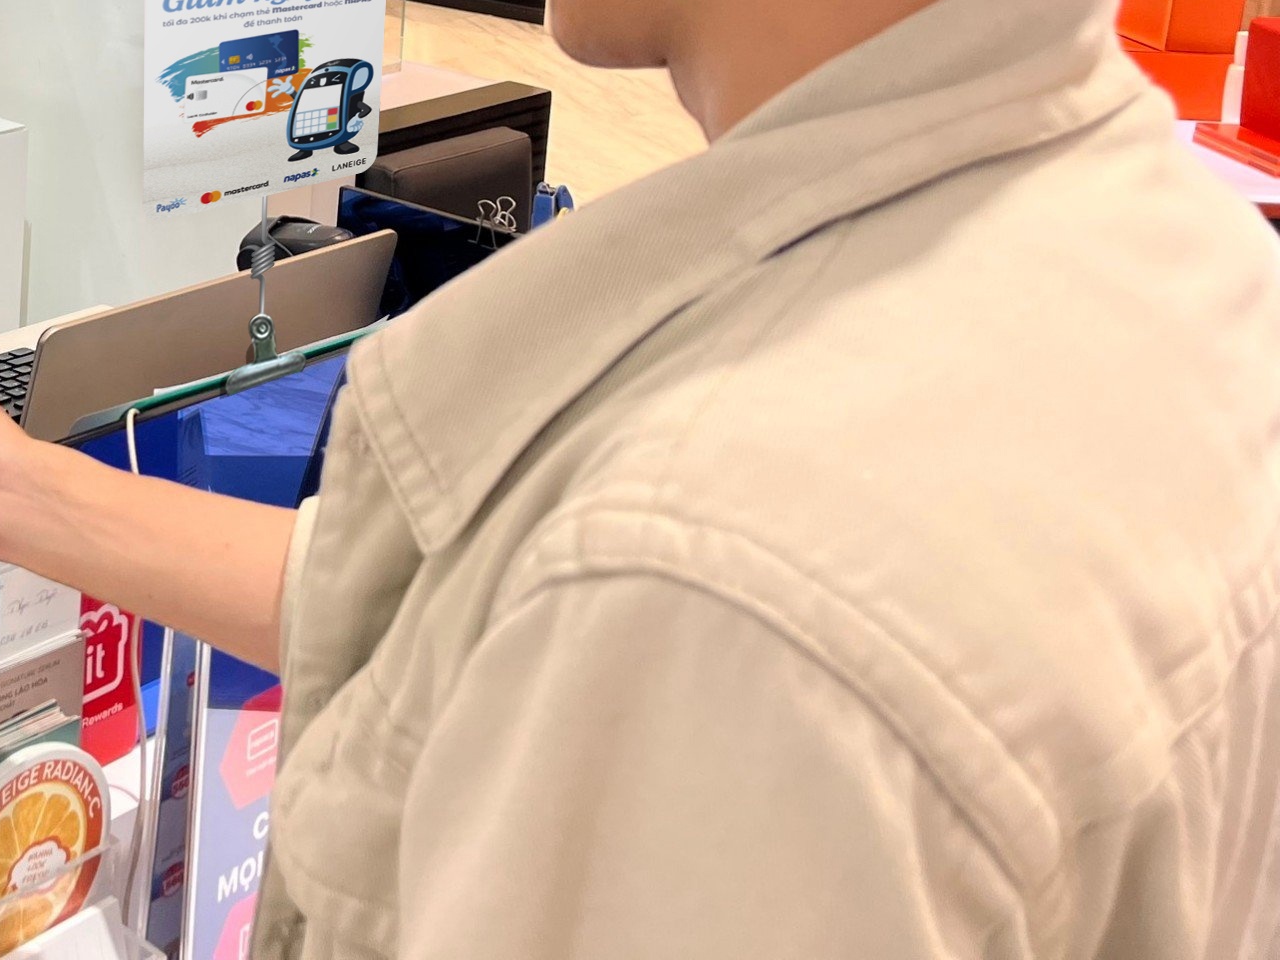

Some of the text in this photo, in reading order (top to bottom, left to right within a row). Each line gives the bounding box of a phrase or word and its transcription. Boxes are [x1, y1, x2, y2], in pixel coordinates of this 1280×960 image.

[176, 17, 189, 26] đa
[190, 15, 212, 24] 200k
[213, 11, 228, 22] khi
[229, 9, 255, 20] chạm
[272, 1, 323, 14] Mastercard
[256, 16, 282, 27] thanh
[284, 14, 303, 23] toán
[223, 180, 270, 197] mastercard
[331, 157, 367, 172] LANEIGE
[86, 642, 106, 686] it
[82, 702, 124, 729] Rewards
[42, 759, 101, 819] RADIAN-C
[217, 850, 265, 902] MỌI
